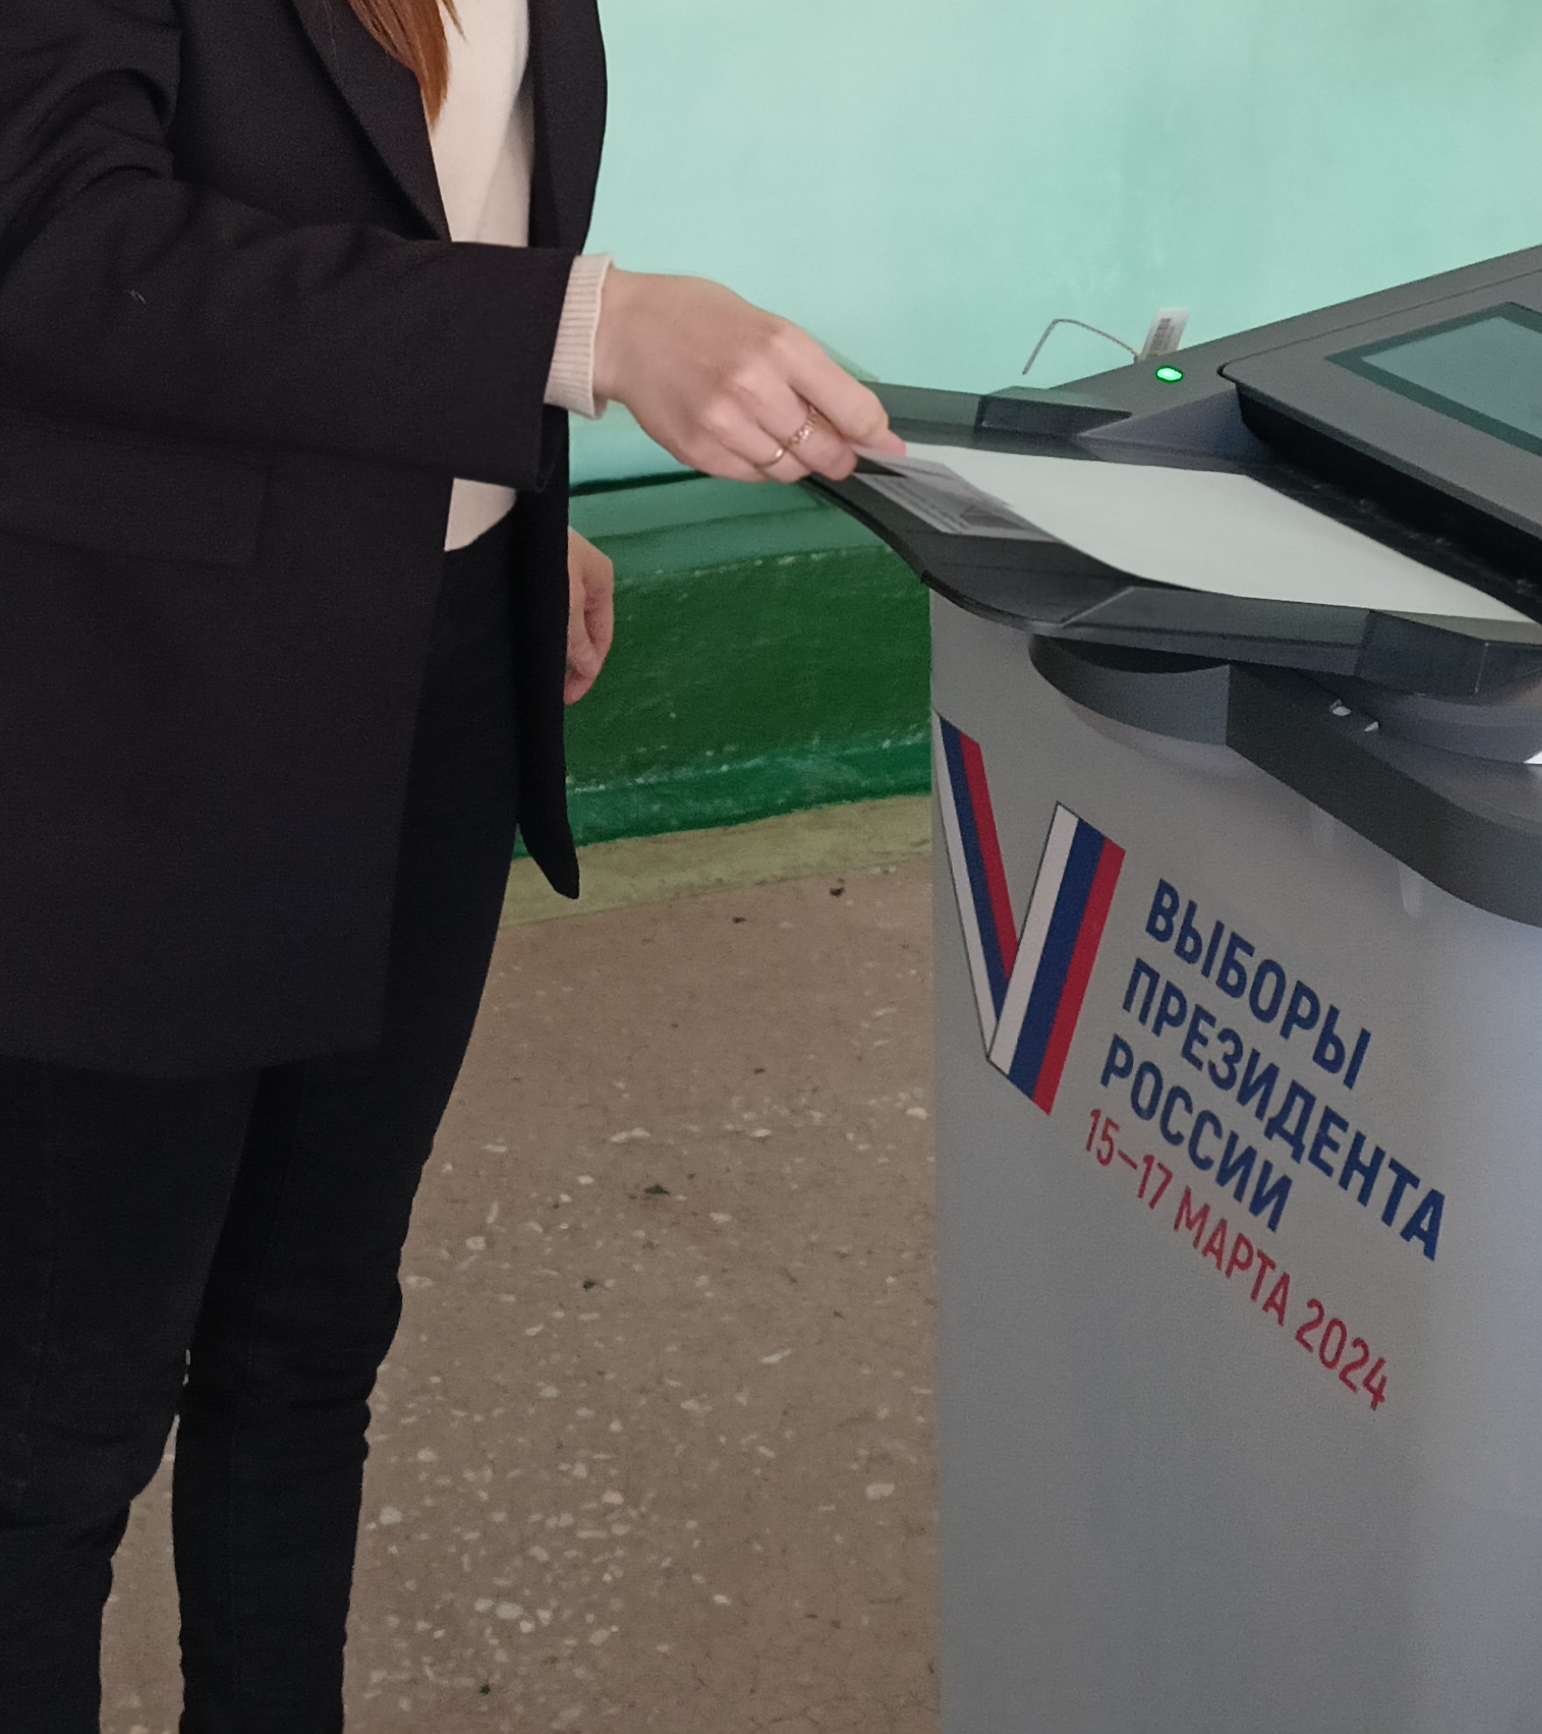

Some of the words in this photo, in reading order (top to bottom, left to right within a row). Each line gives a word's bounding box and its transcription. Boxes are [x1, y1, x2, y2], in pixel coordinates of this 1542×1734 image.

[1145, 878, 1371, 1090] ВЫБОРЫ
[1100, 1033, 1293, 1233] РОССИИ
[1121, 958, 1446, 1262] ПРЕЗИДЕНТА
[1173, 1188, 1291, 1327] МАРТА
[1296, 1299, 1388, 1412] 2024
